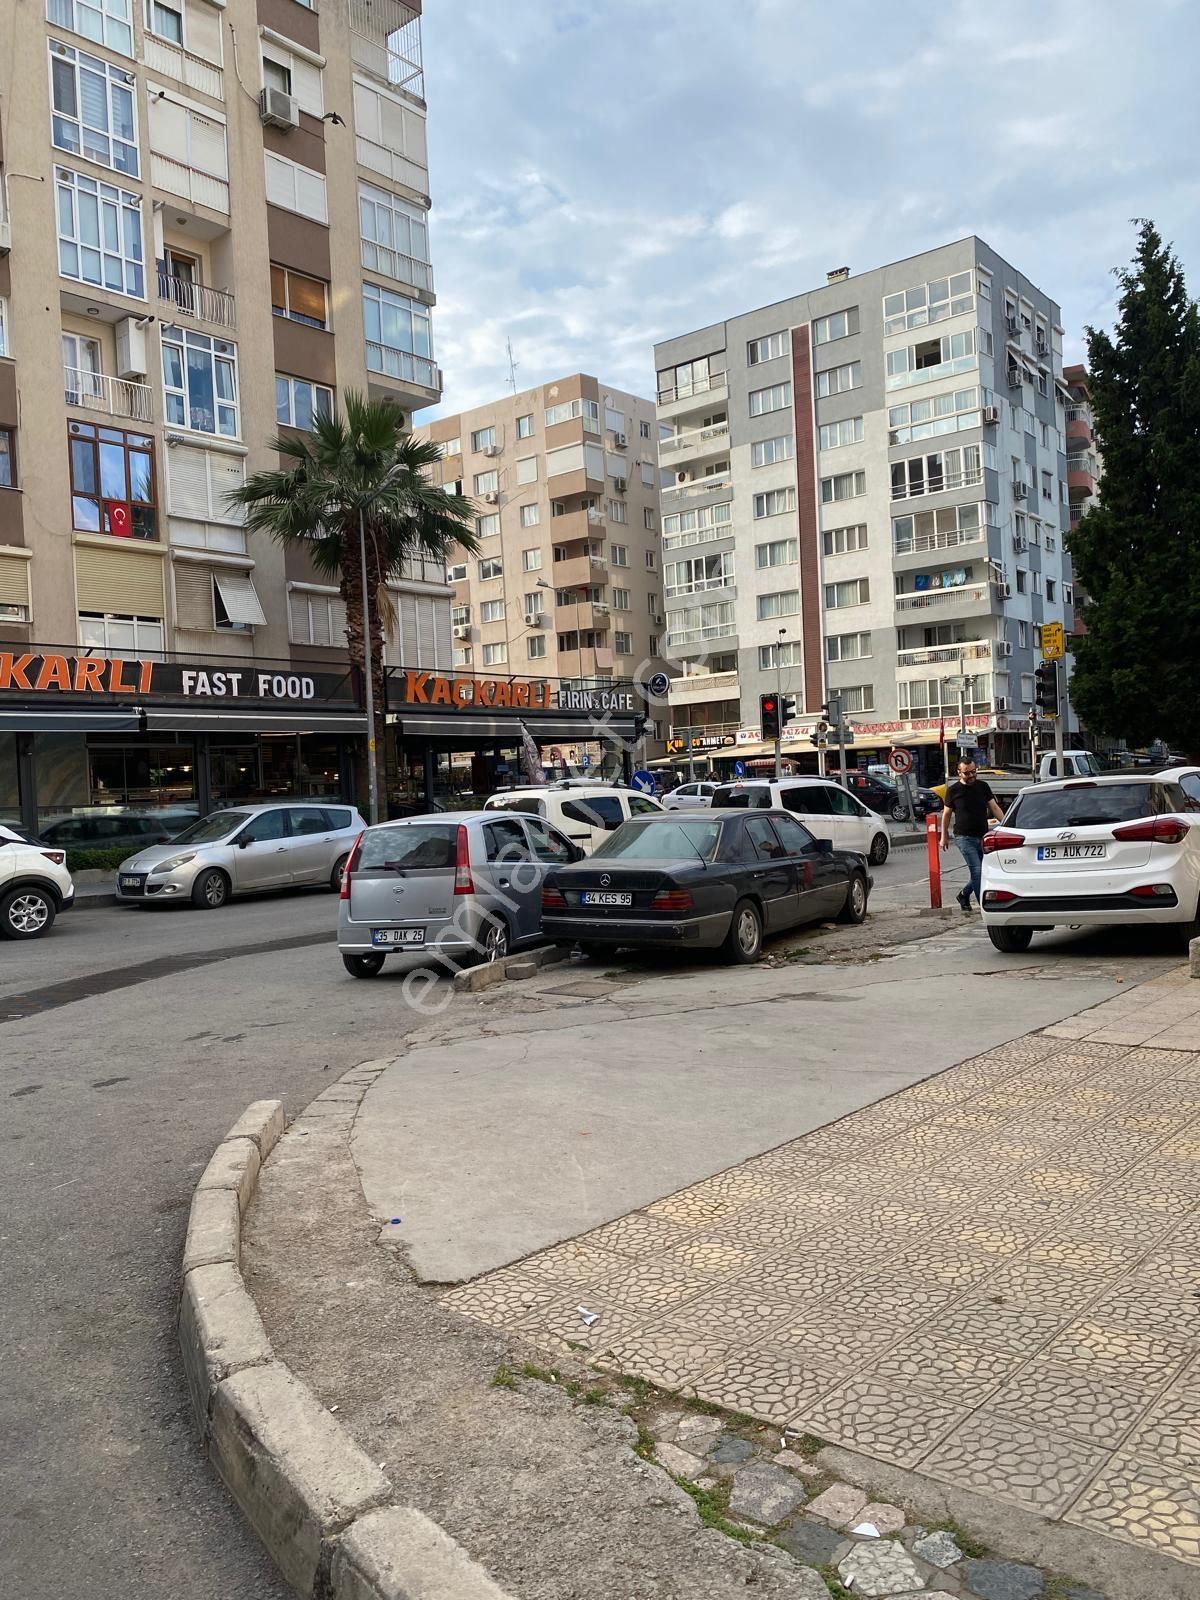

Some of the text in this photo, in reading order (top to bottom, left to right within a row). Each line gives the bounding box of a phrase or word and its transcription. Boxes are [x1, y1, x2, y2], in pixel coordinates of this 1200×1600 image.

[0, 653, 315, 699] KARLI FAST FOOD
[404, 671, 551, 710] KAÇKARLI
[559, 691, 592, 709] FIRIN
[602, 692, 634, 710] CAFE
[1044, 845, 1103, 858] 35 AUK 722
[585, 893, 631, 904] 34 KES 95
[378, 931, 388, 941] 35
[412, 930, 423, 940] 25
